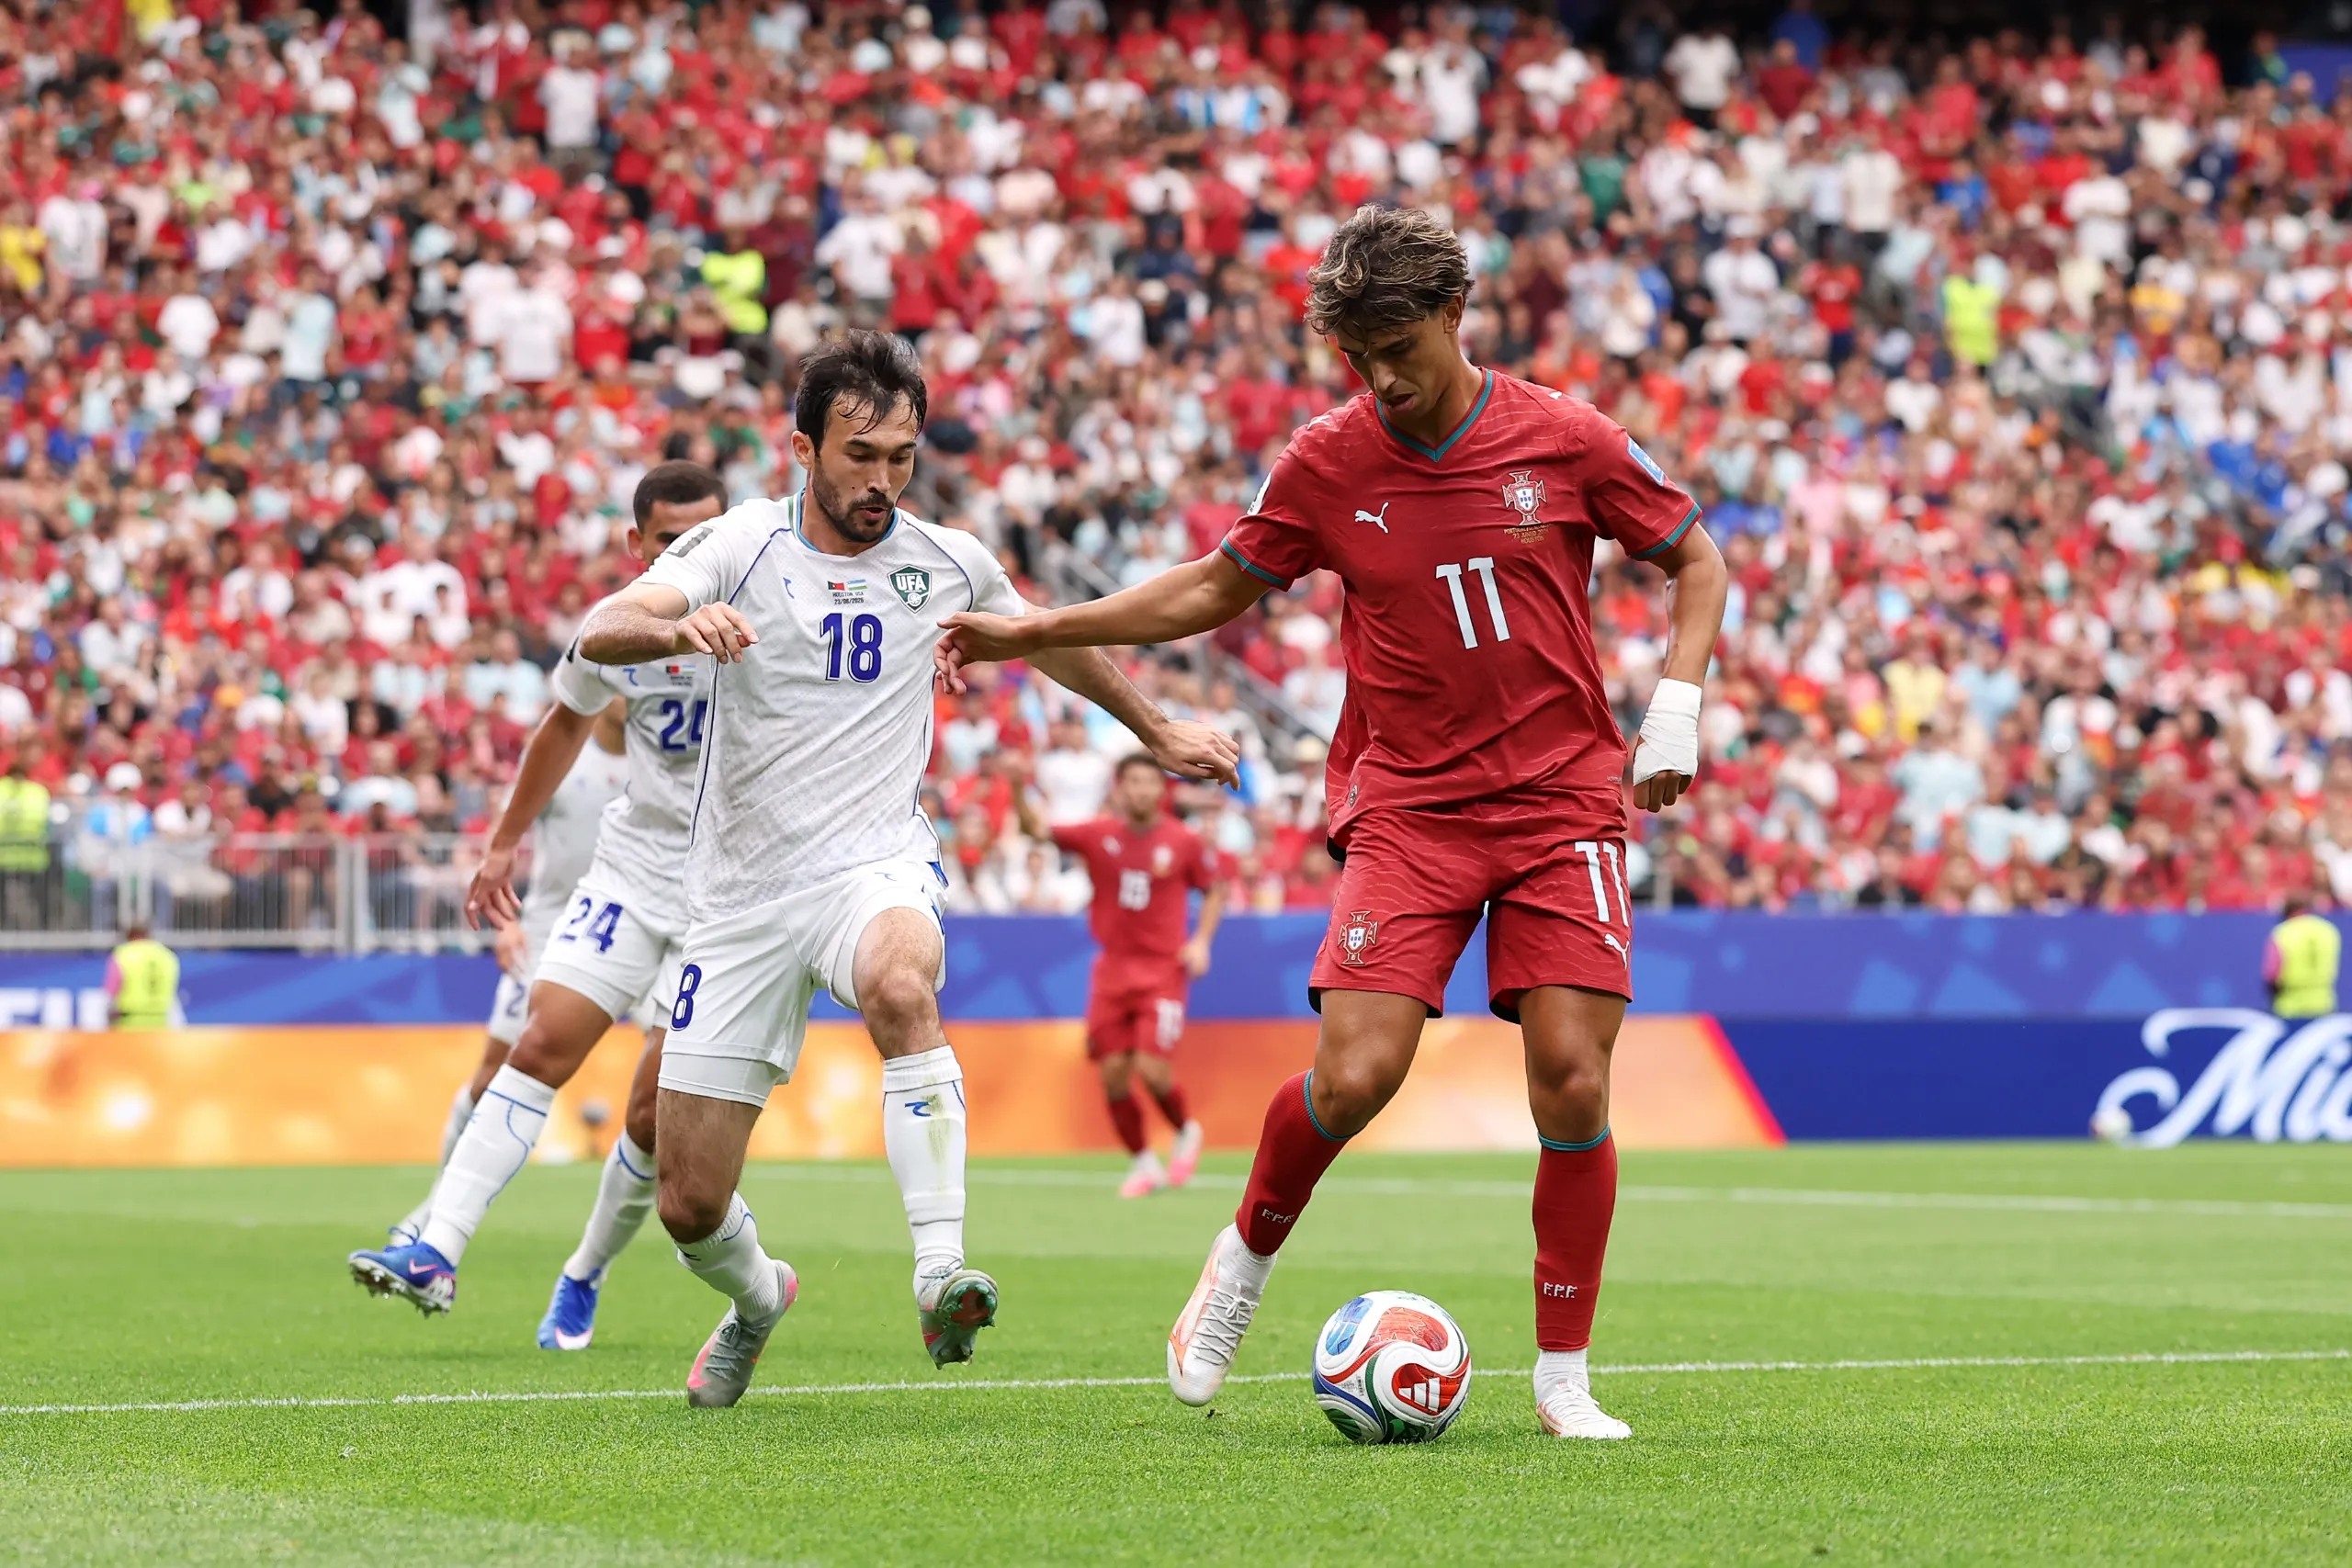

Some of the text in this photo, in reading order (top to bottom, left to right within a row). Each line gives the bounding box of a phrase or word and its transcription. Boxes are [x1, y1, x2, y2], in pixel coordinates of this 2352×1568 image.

[895, 574, 927, 592] UFA
[1435, 556, 1511, 649] 11
[820, 613, 883, 683] 18
[1575, 840, 1630, 928] 11
[559, 897, 625, 954] 24
